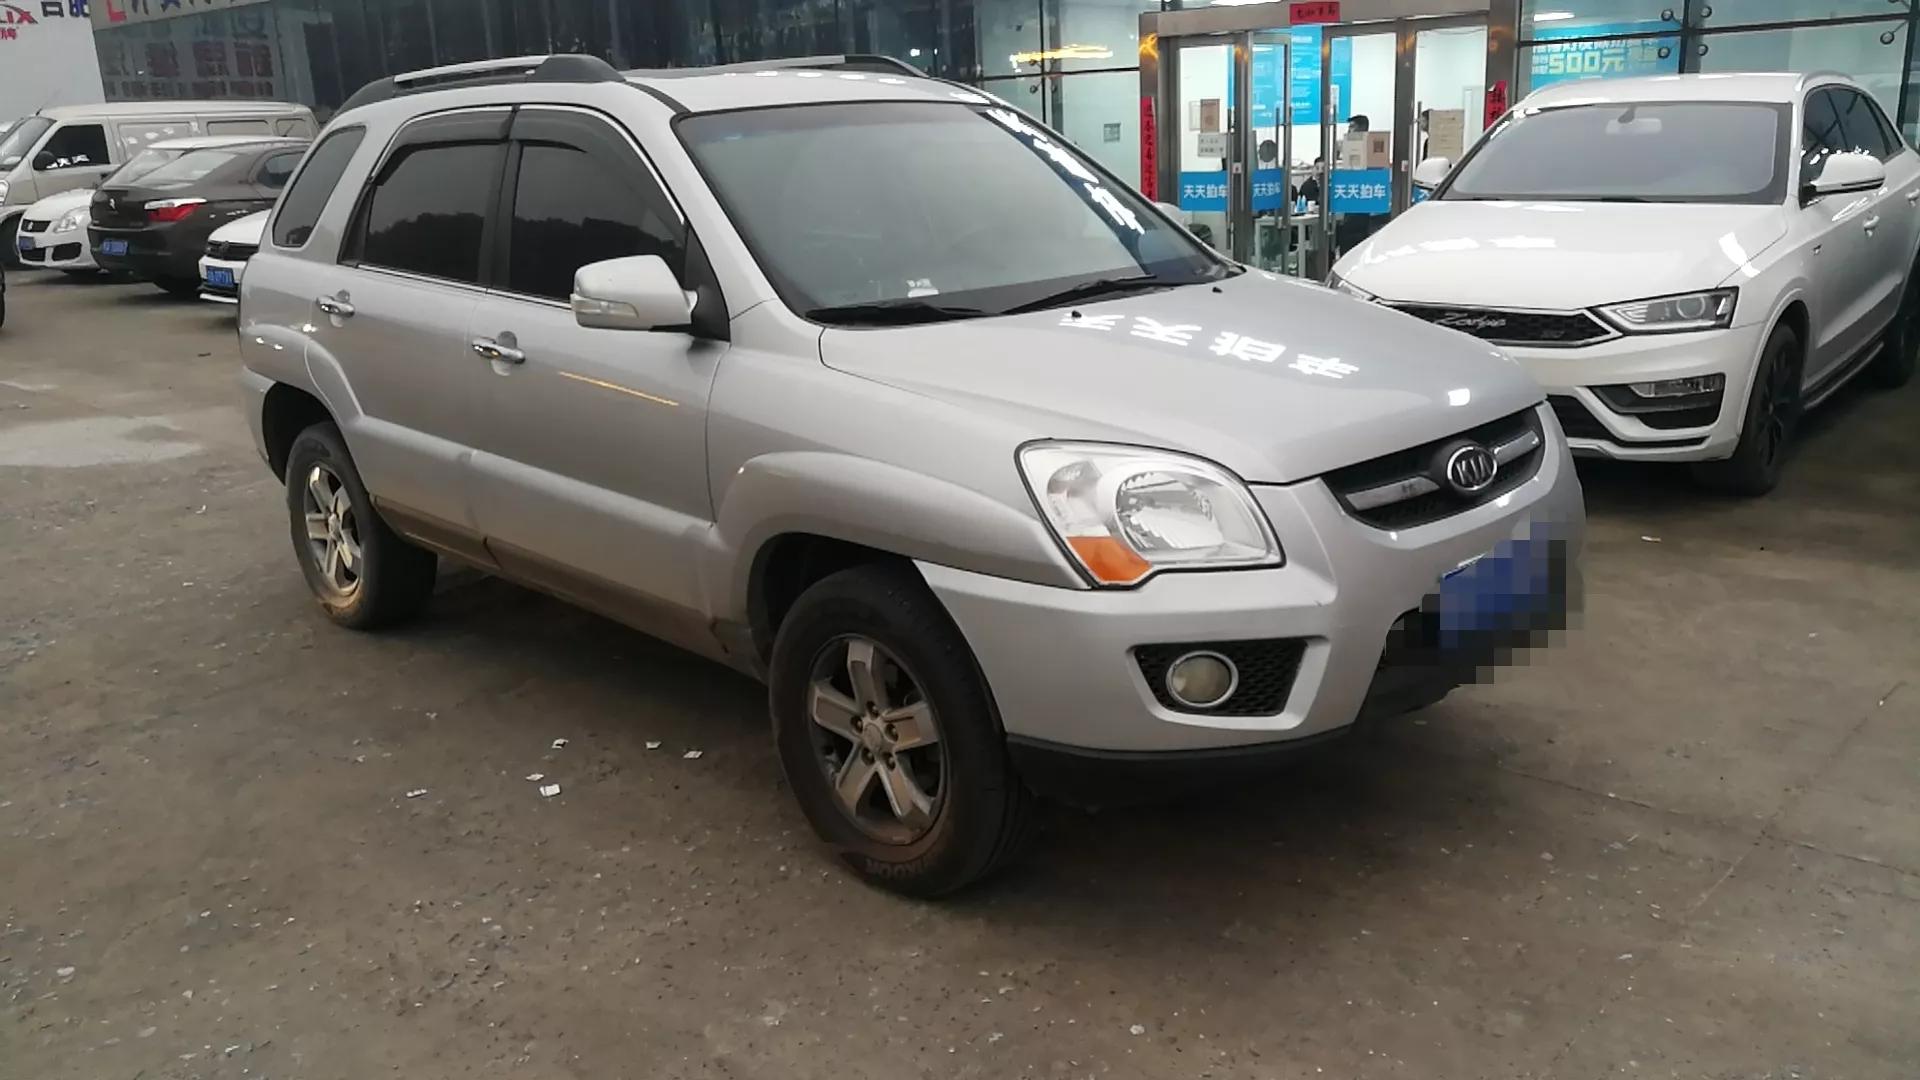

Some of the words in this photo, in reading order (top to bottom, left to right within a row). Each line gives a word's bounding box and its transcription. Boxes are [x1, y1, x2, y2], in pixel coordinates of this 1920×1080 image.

[1334, 184, 1386, 199] 天天拍车
[1455, 453, 1492, 485] KIA
